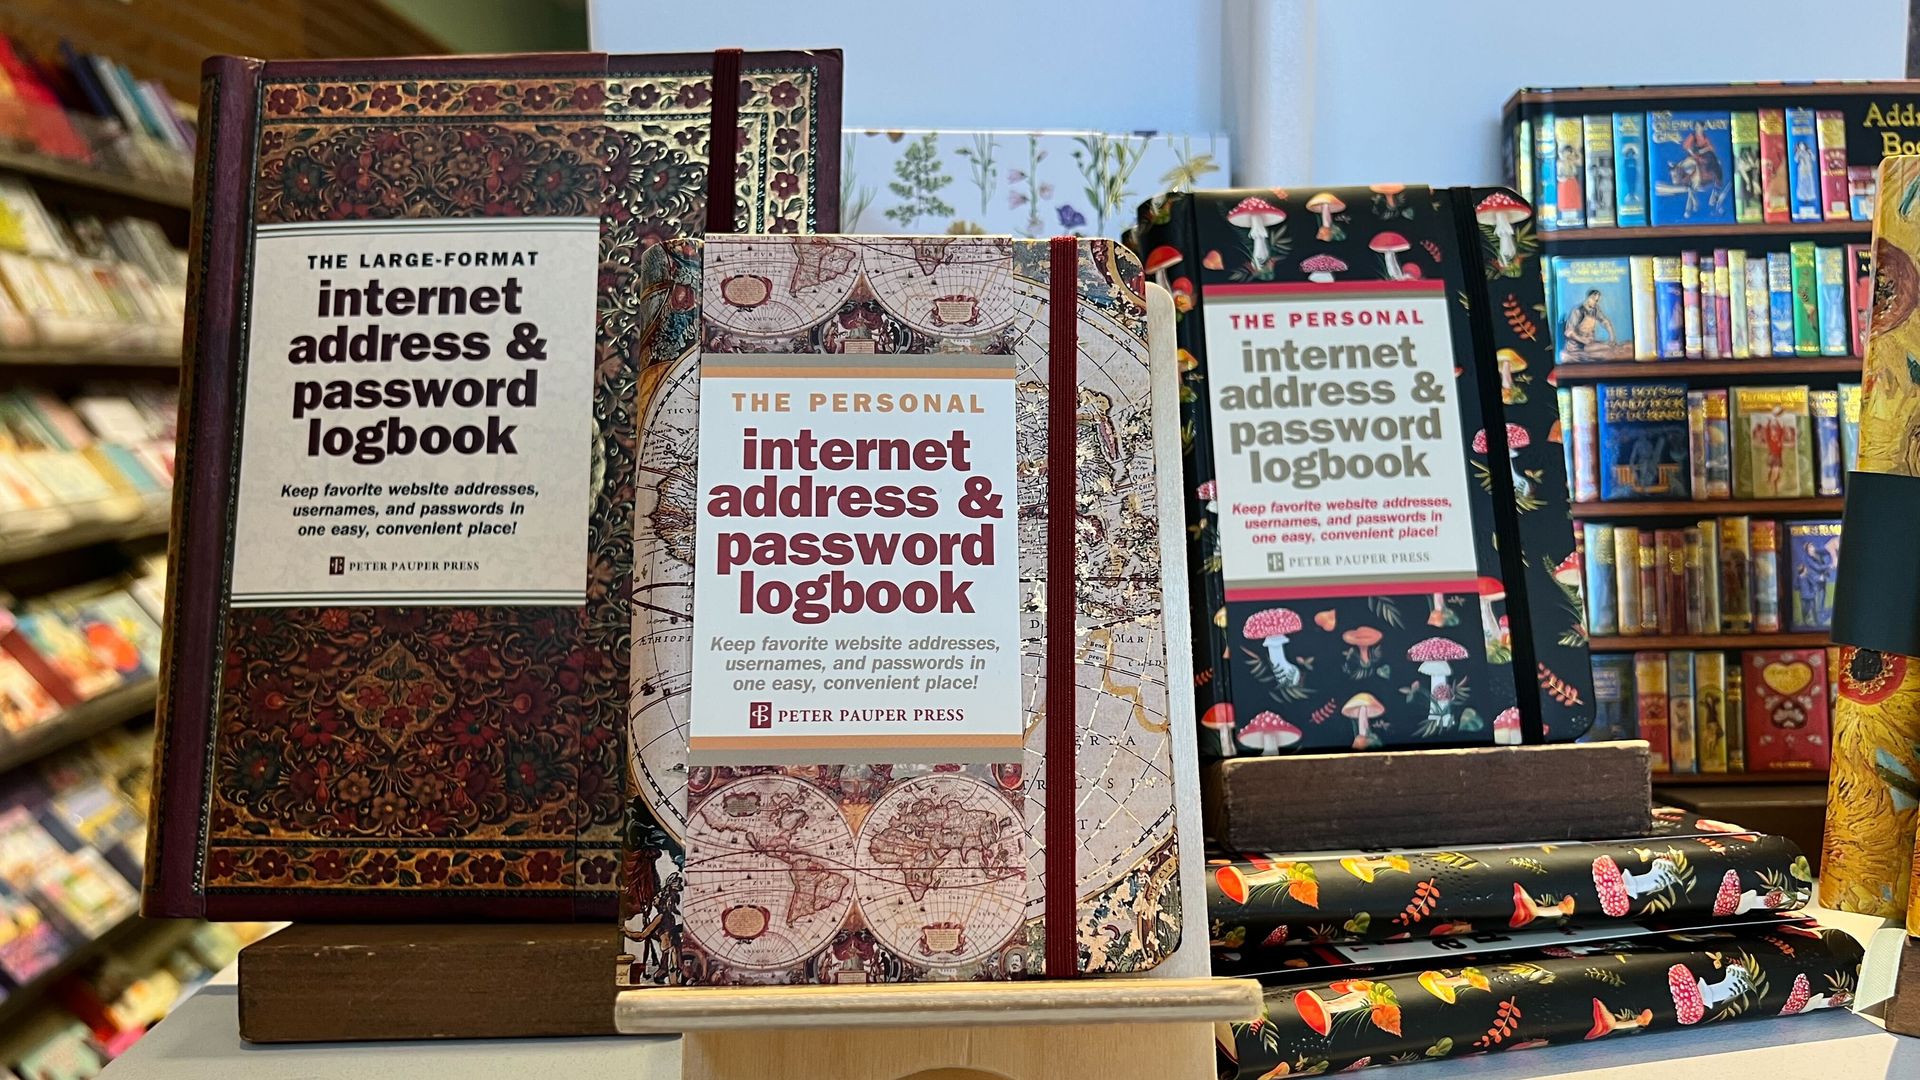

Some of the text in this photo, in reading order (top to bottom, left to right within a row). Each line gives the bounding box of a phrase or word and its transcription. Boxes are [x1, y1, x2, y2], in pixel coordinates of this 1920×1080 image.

[308, 252, 538, 269] THE LARGE-FORMAT
[318, 278, 522, 317] internet
[1230, 310, 1423, 329] THE PERSONAL
[288, 322, 547, 364] address &
[1242, 336, 1417, 373] internet
[293, 369, 537, 419] password
[1220, 371, 1445, 410] address &
[732, 393, 984, 413] THE PERSONAL
[308, 416, 517, 465] logbook
[1230, 408, 1442, 454] password
[744, 428, 970, 471] internet
[1250, 445, 1430, 489] logbook
[281, 482, 538, 499] Keep favorite website addresses,
[707, 475, 1003, 518] address &
[293, 502, 524, 518] usernames, and passwords in
[1232, 497, 1451, 516] Keep favorite website addresses,
[1245, 510, 1442, 529] usernames, and passwords in
[298, 522, 517, 538] one easy, convenient place!
[1252, 525, 1438, 544] one easy, convenient place!
[717, 524, 994, 575] password
[350, 562, 479, 571] PETER PAUPER PRESS
[1289, 552, 1429, 567] PETER PAUPER PRESS
[740, 571, 975, 624] logbook
[711, 636, 999, 654] Keep favorite website addresses,
[726, 655, 985, 673] usernames, and passwords in
[733, 675, 978, 693] one easy, convenient place!
[779, 709, 963, 722] PETER PAUPER PRESS
